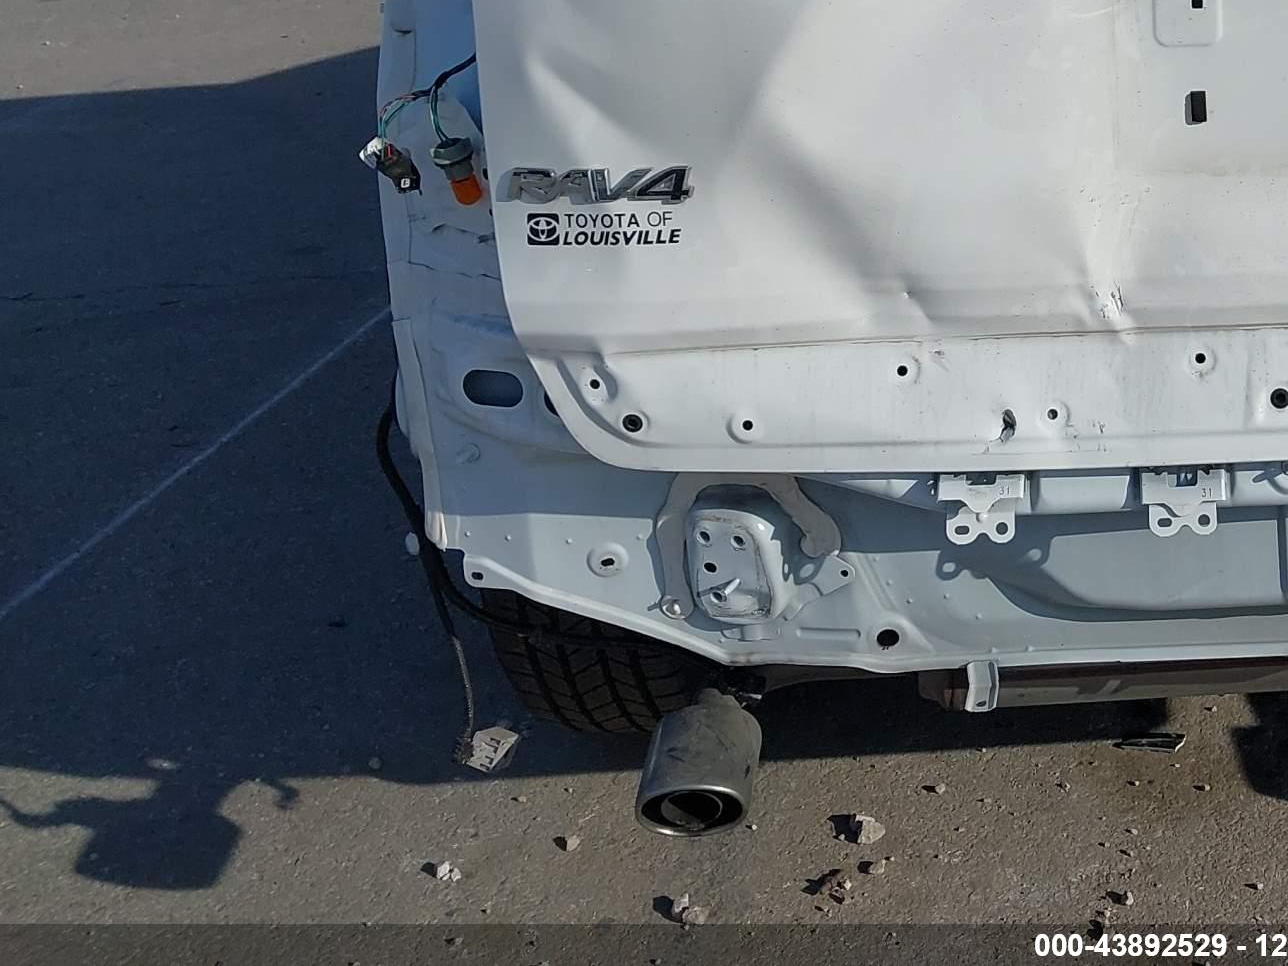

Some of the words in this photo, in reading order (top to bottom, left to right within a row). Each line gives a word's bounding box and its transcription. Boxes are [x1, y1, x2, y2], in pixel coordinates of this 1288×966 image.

[497, 166, 695, 205] RAV4
[563, 212, 641, 229] TOYOTA
[646, 211, 673, 227] OF
[562, 228, 682, 246] LOUISVILLE
[1201, 487, 1212, 498] 31
